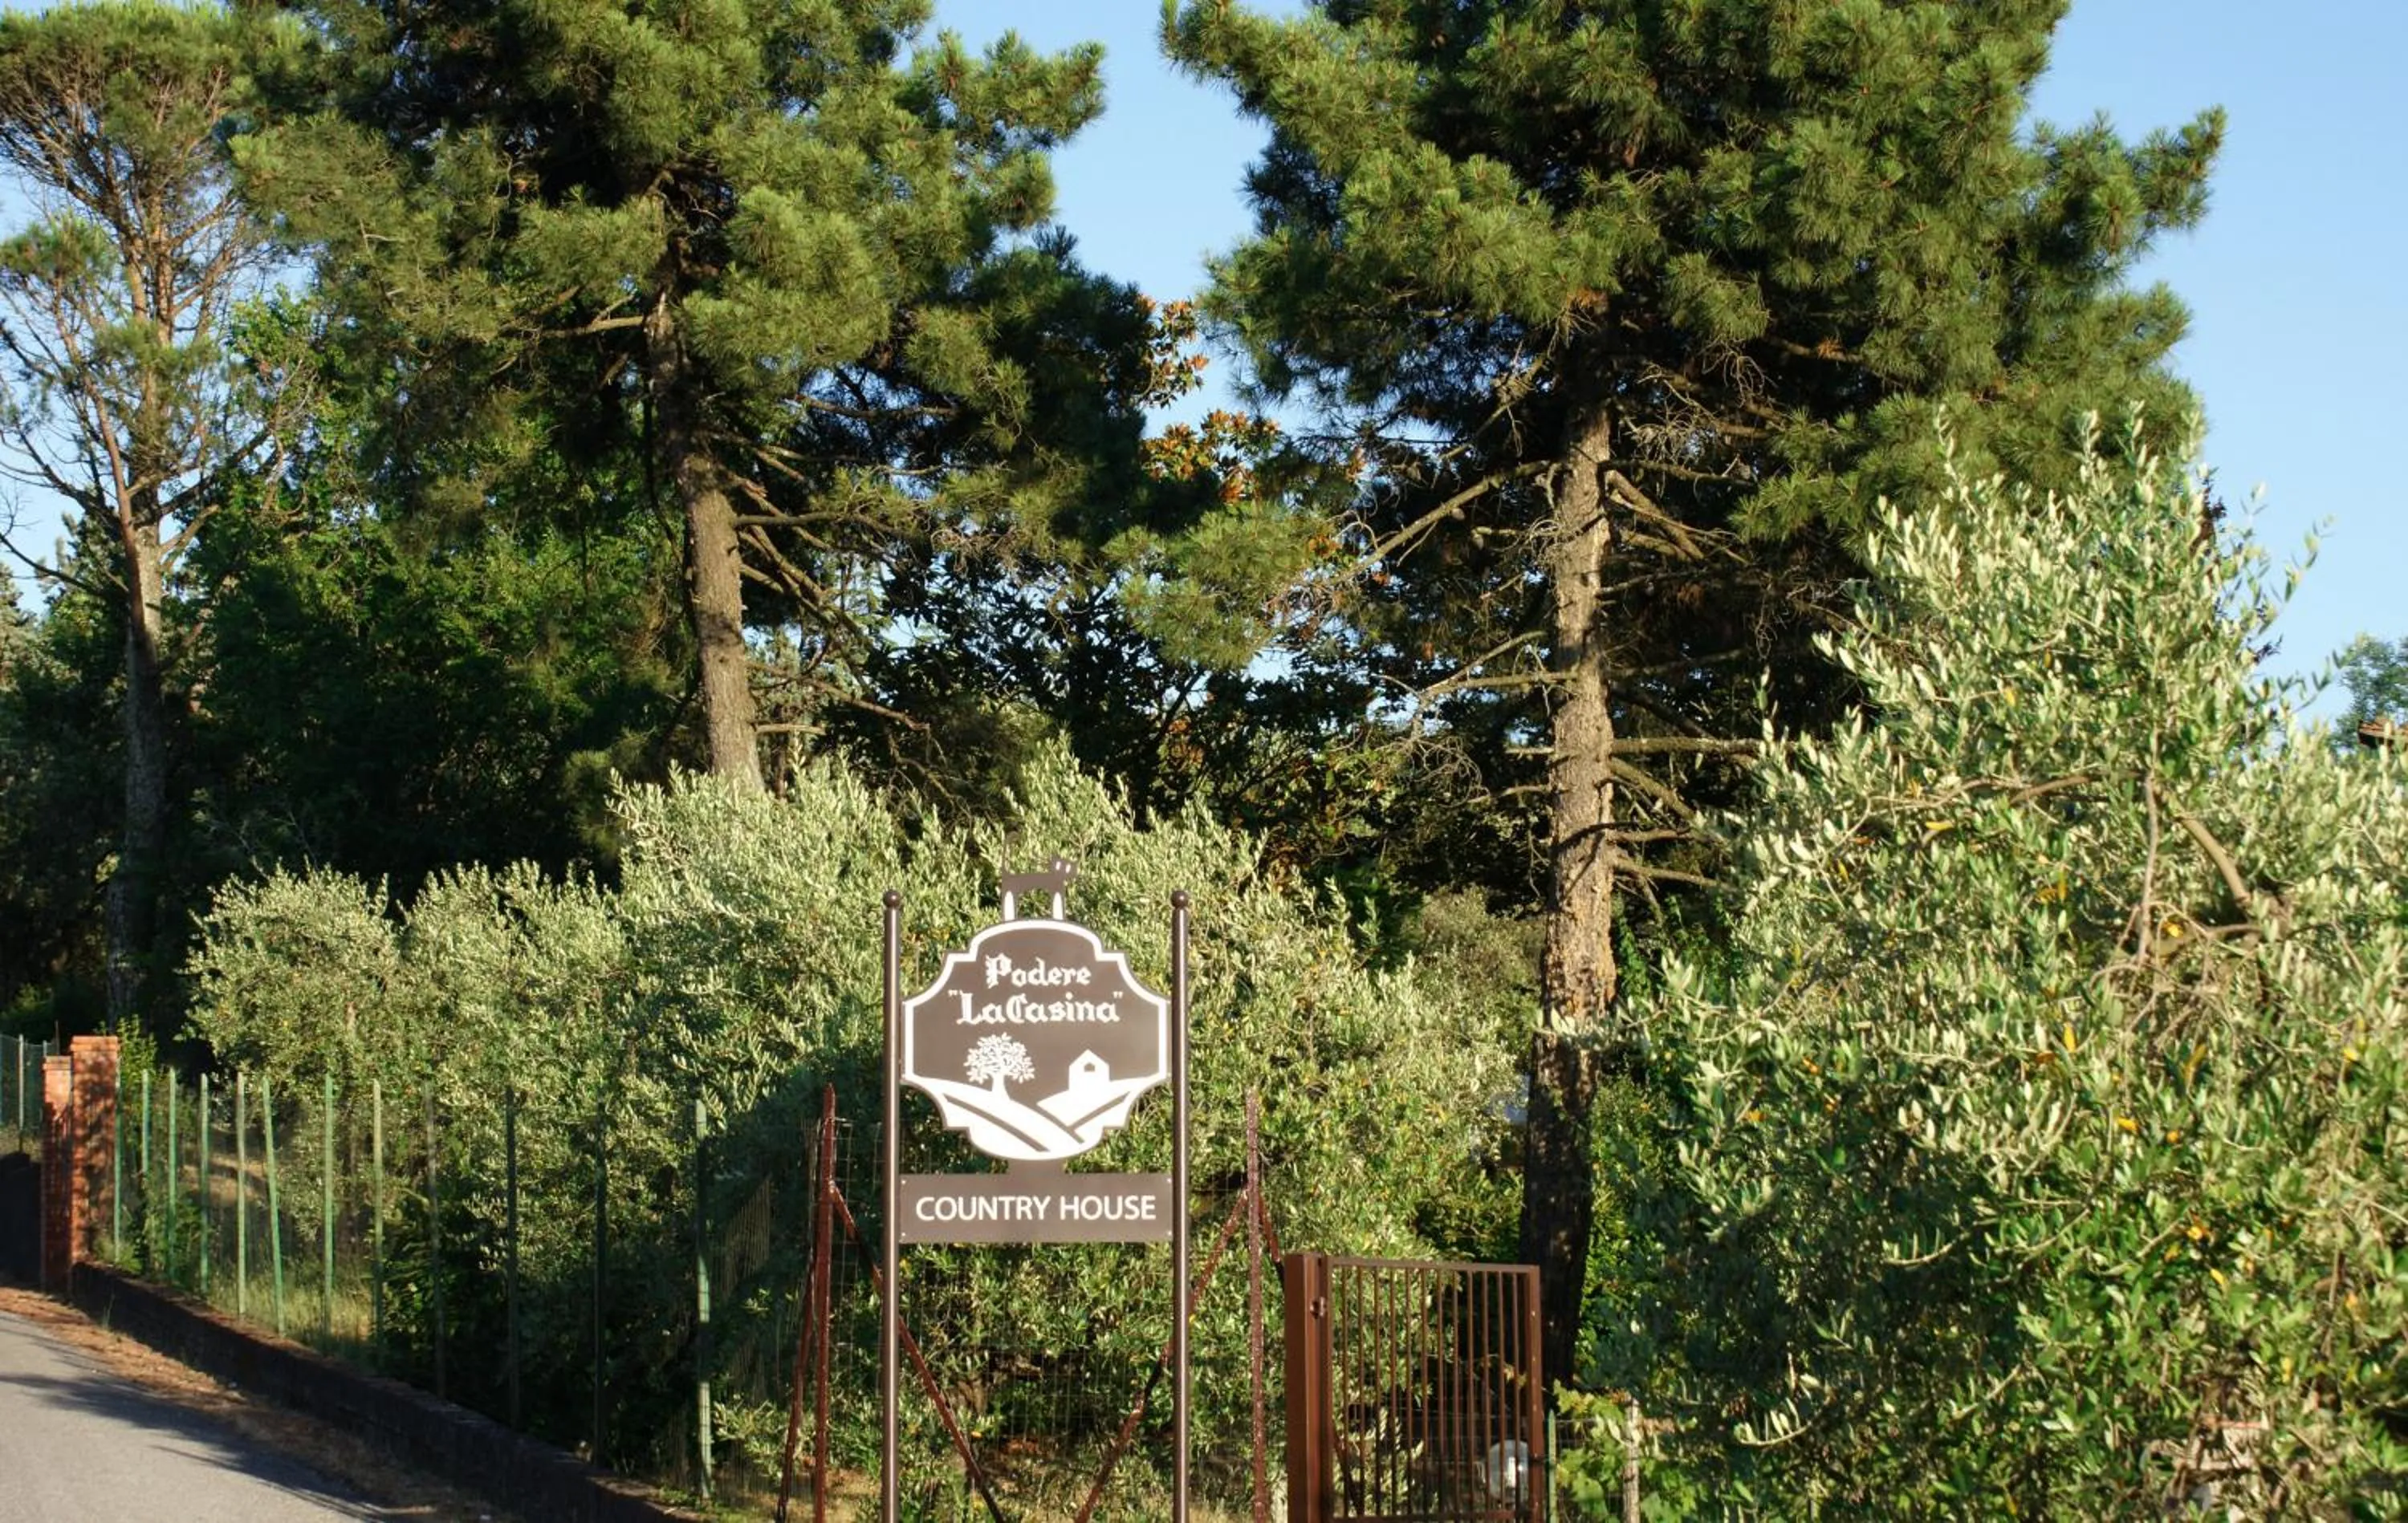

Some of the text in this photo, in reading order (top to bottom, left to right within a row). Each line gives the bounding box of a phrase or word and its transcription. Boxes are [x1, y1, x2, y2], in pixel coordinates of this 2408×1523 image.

[985, 952, 1092, 989] Podere
[916, 1194, 1157, 1221] COUNTRY HOUSE
